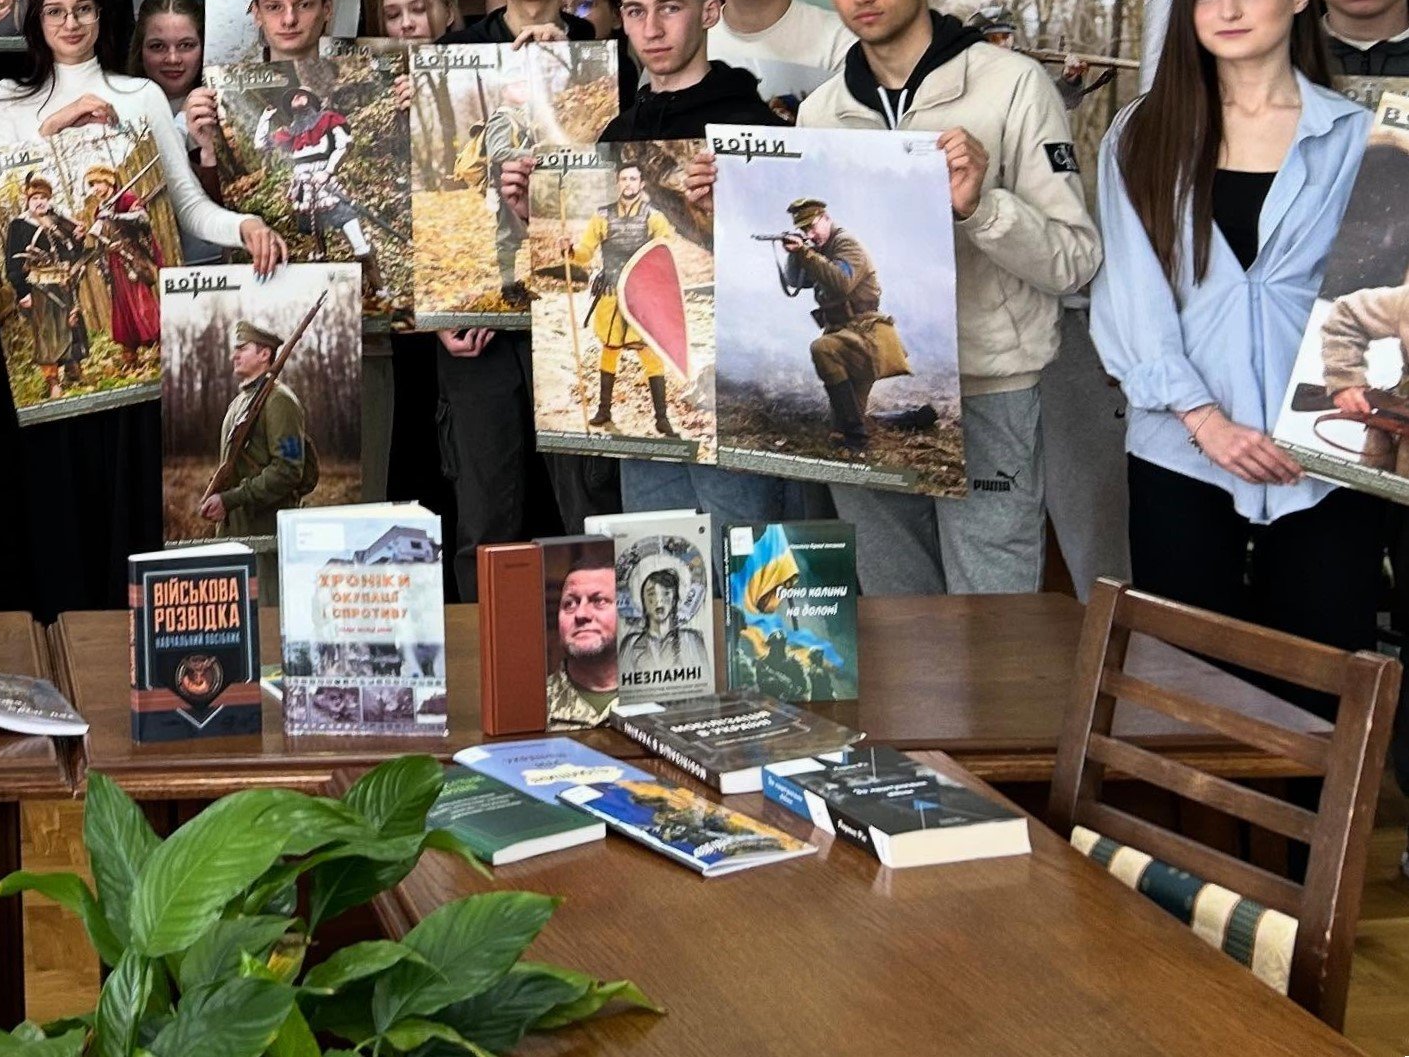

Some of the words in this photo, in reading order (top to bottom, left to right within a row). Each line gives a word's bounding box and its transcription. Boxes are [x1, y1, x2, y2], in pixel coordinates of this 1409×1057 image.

[154, 577, 240, 606] ВІЙСЬКОВА
[319, 574, 411, 587] ХРОНІКИ
[154, 603, 241, 633] РОЗВІДКА
[621, 666, 702, 687] НЕЗЛАМНІ
